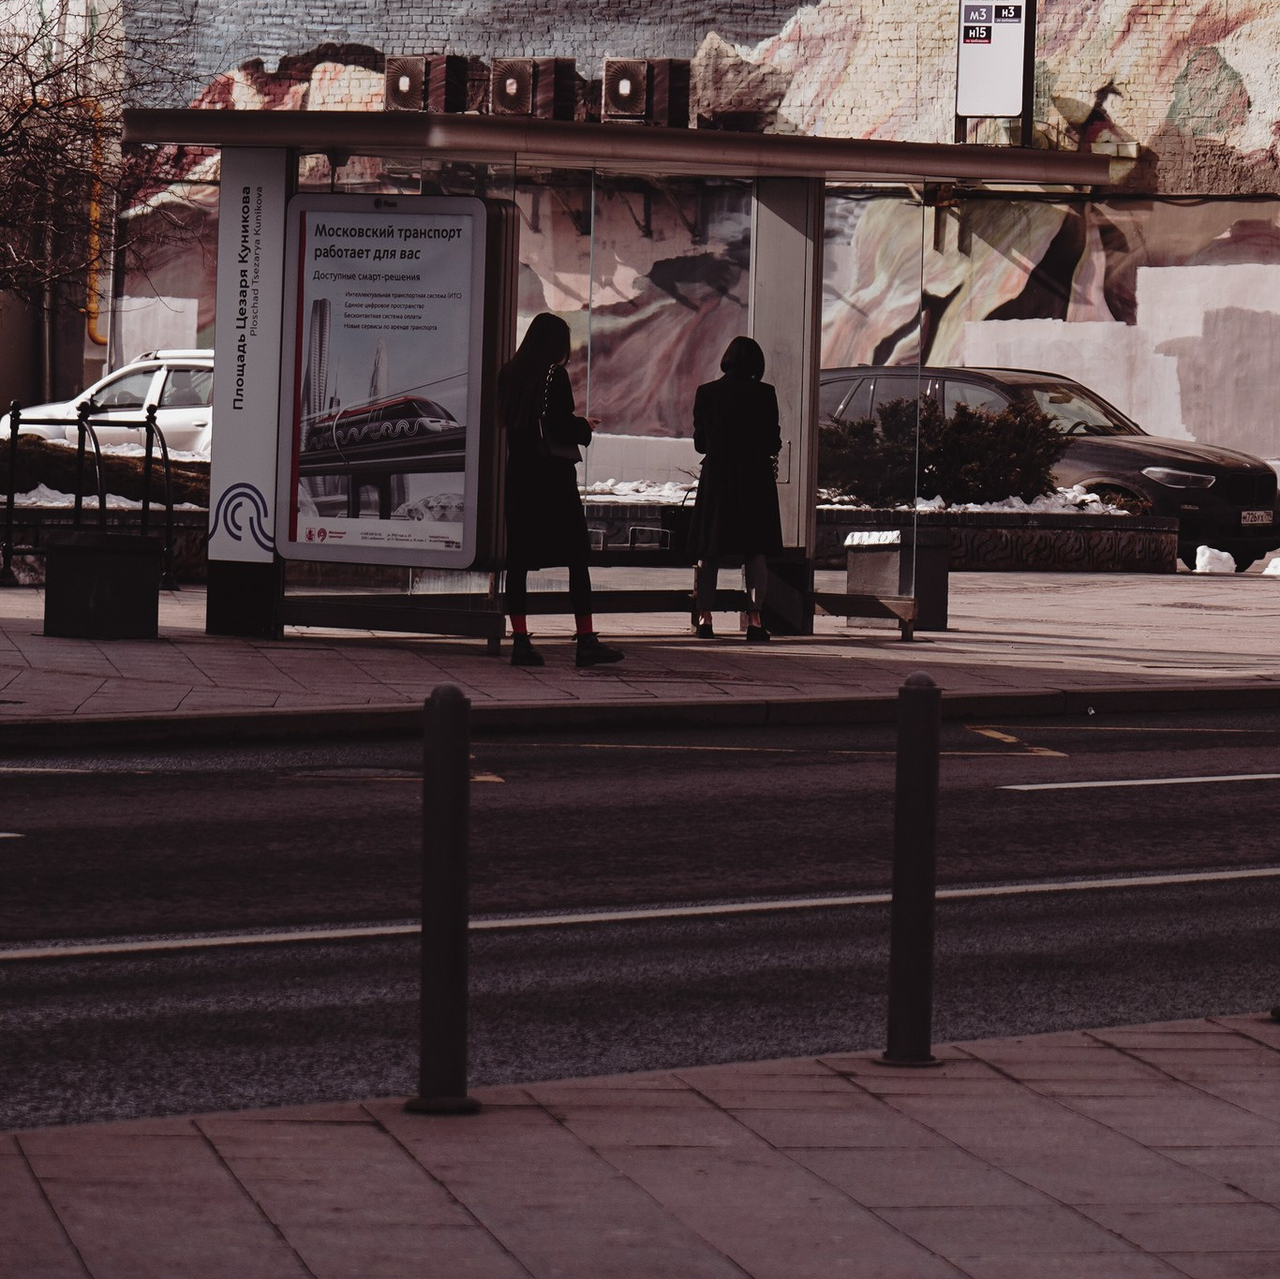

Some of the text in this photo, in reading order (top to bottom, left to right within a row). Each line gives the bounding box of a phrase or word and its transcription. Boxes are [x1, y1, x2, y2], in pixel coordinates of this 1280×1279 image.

[315, 223, 462, 242] Московский транспорт
[250, 186, 262, 336] Ploschad Tsezarya Kunikova
[314, 244, 421, 261] работает для вас
[313, 270, 421, 282] Доступные смарт-решения
[233, 186, 251, 410] Площадь Цезаря Куникова
